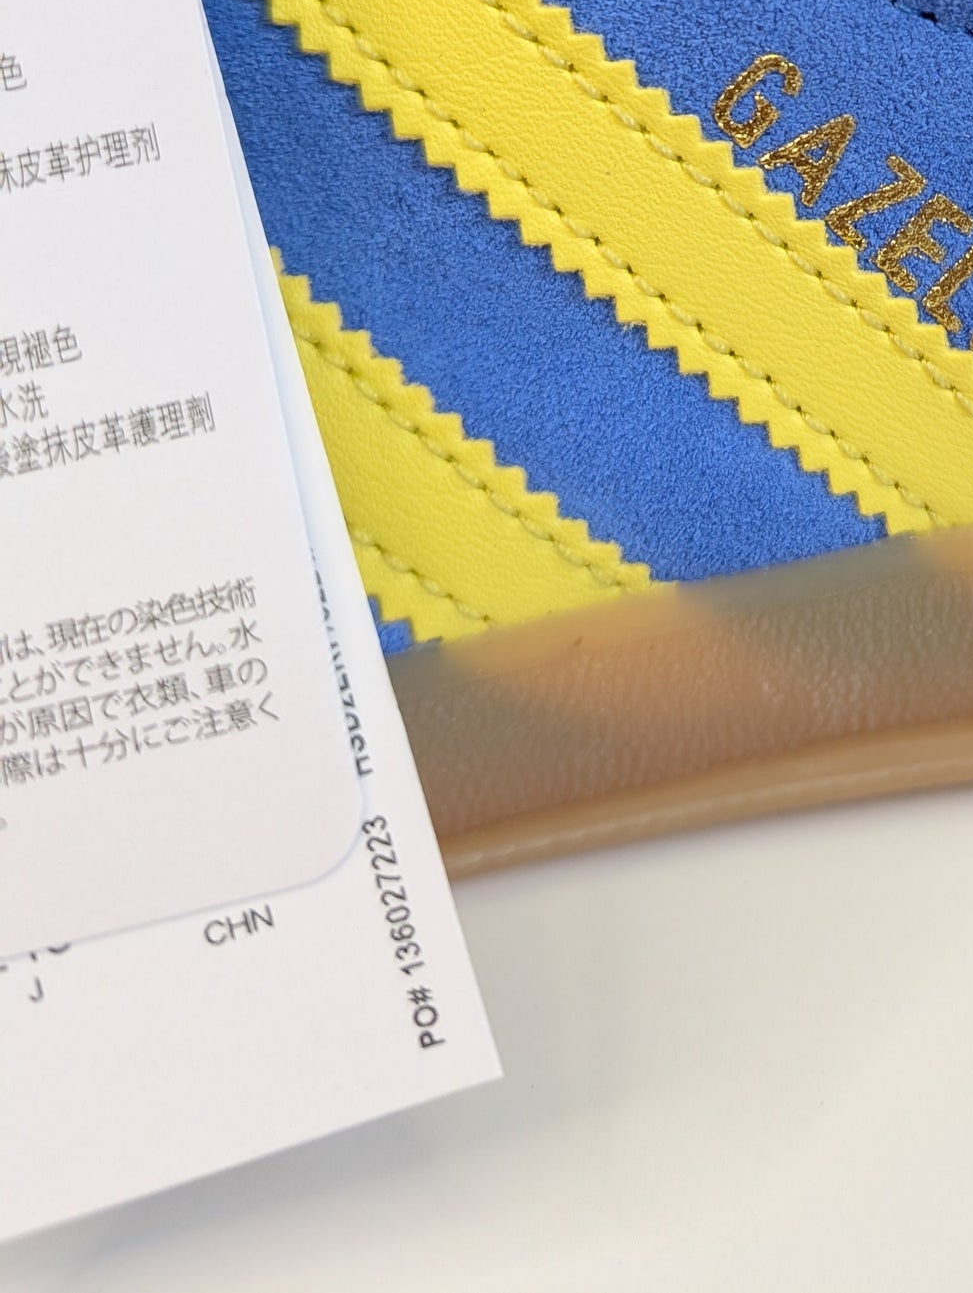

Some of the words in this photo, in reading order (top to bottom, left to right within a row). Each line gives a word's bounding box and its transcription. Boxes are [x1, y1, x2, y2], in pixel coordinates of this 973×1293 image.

[0, 576, 257, 664] は、現在の染色技術
[203, 904, 275, 946] CHN
[361, 814, 426, 977] 136027223
[408, 984, 446, 1050] PO#
